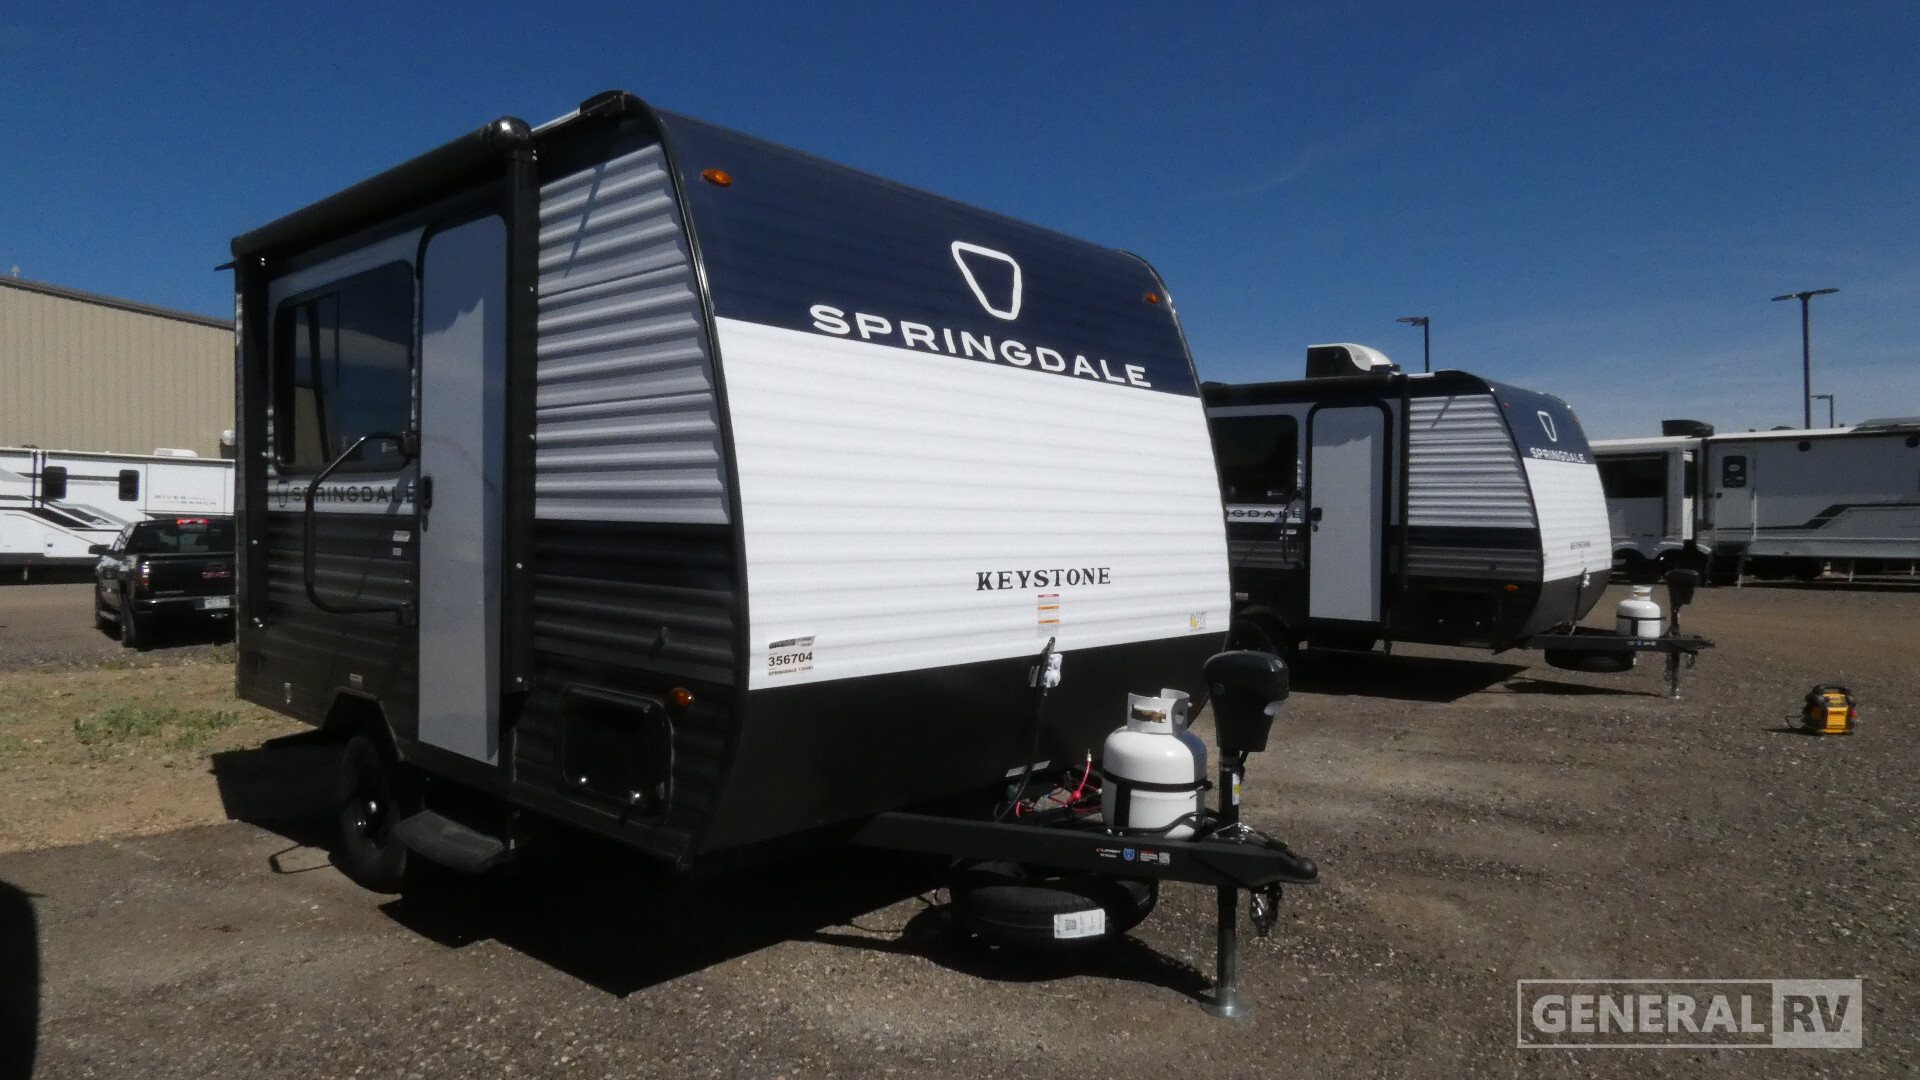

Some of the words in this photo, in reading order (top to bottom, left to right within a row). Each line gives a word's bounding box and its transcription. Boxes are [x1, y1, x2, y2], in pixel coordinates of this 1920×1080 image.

[809, 304, 1152, 388] SPRINGDALE
[1529, 446, 1587, 463] SPRINGDALE
[1226, 508, 1302, 519] GDALE
[976, 567, 1111, 591] KEYSTONE
[769, 652, 812, 667] 356704
